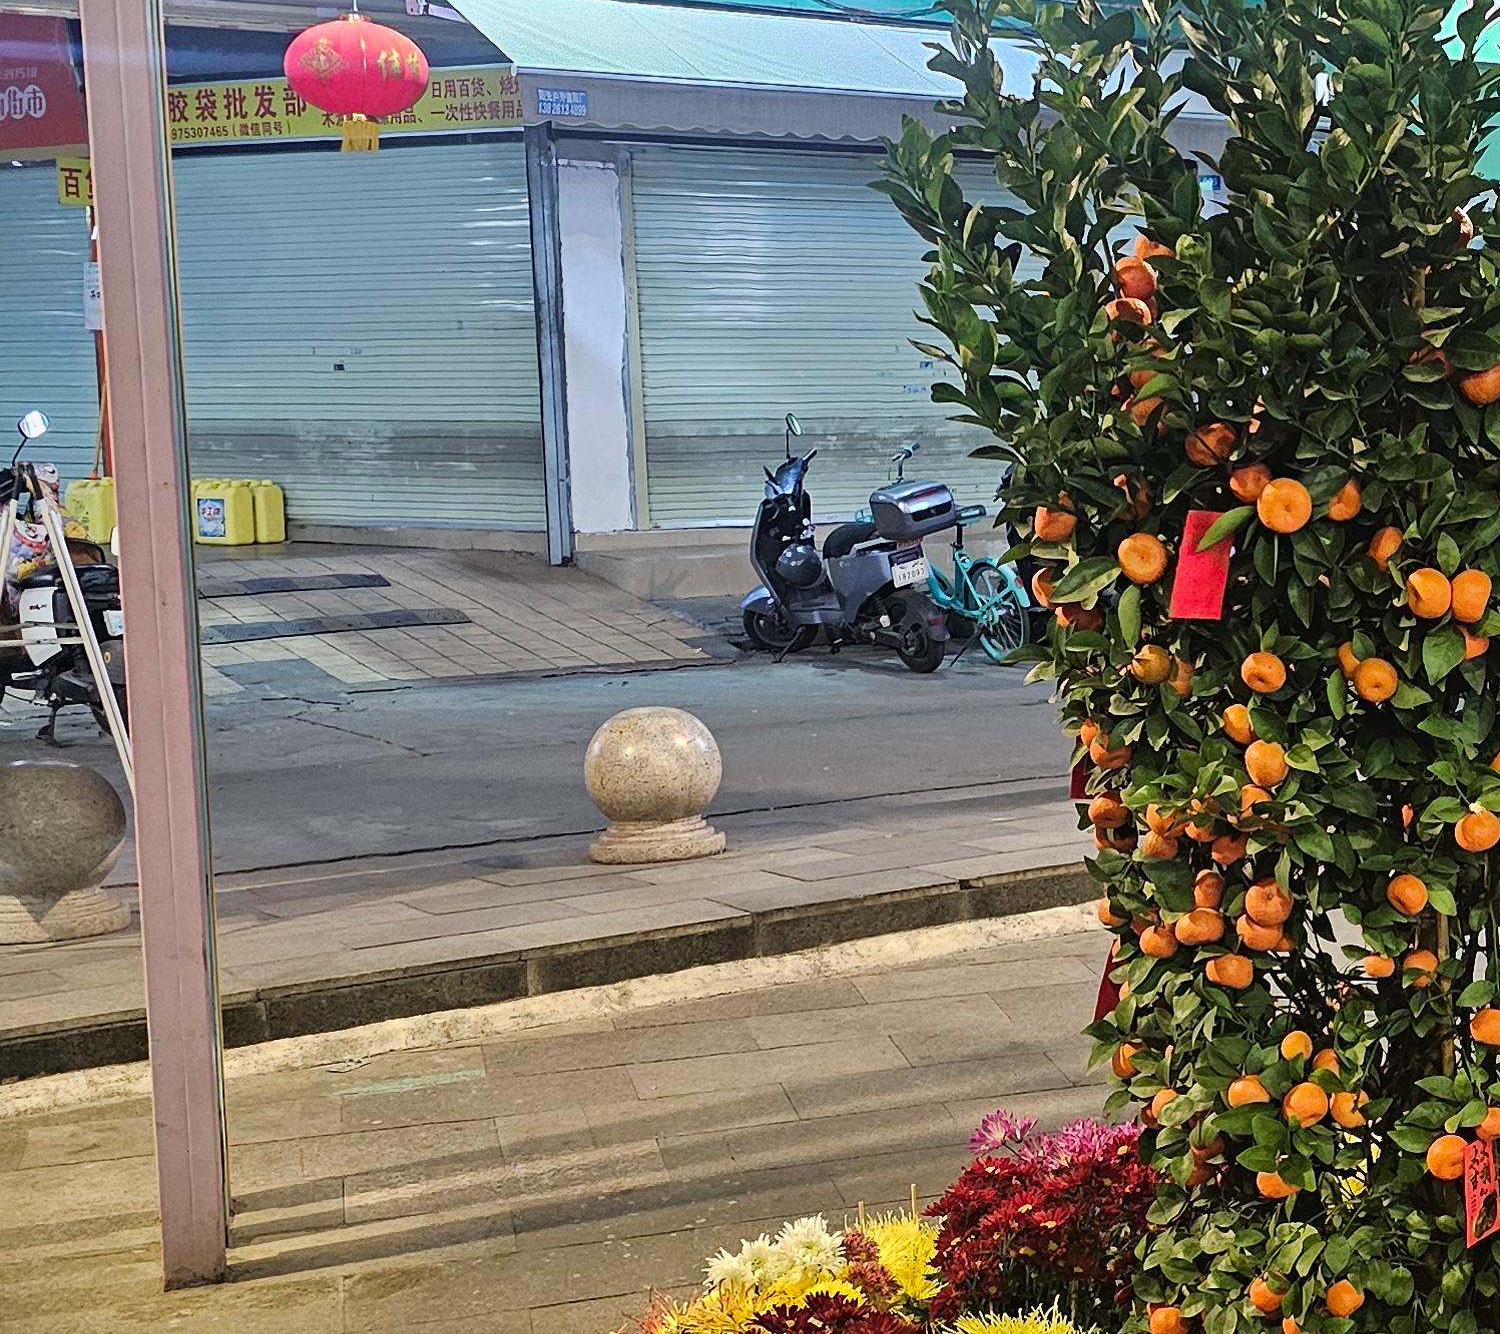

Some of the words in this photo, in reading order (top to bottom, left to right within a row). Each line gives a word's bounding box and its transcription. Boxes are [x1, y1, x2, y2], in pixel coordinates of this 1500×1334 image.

[0, 87, 43, 116] 街市
[167, 84, 307, 124] 胶袋批发部
[60, 167, 93, 200] 百
